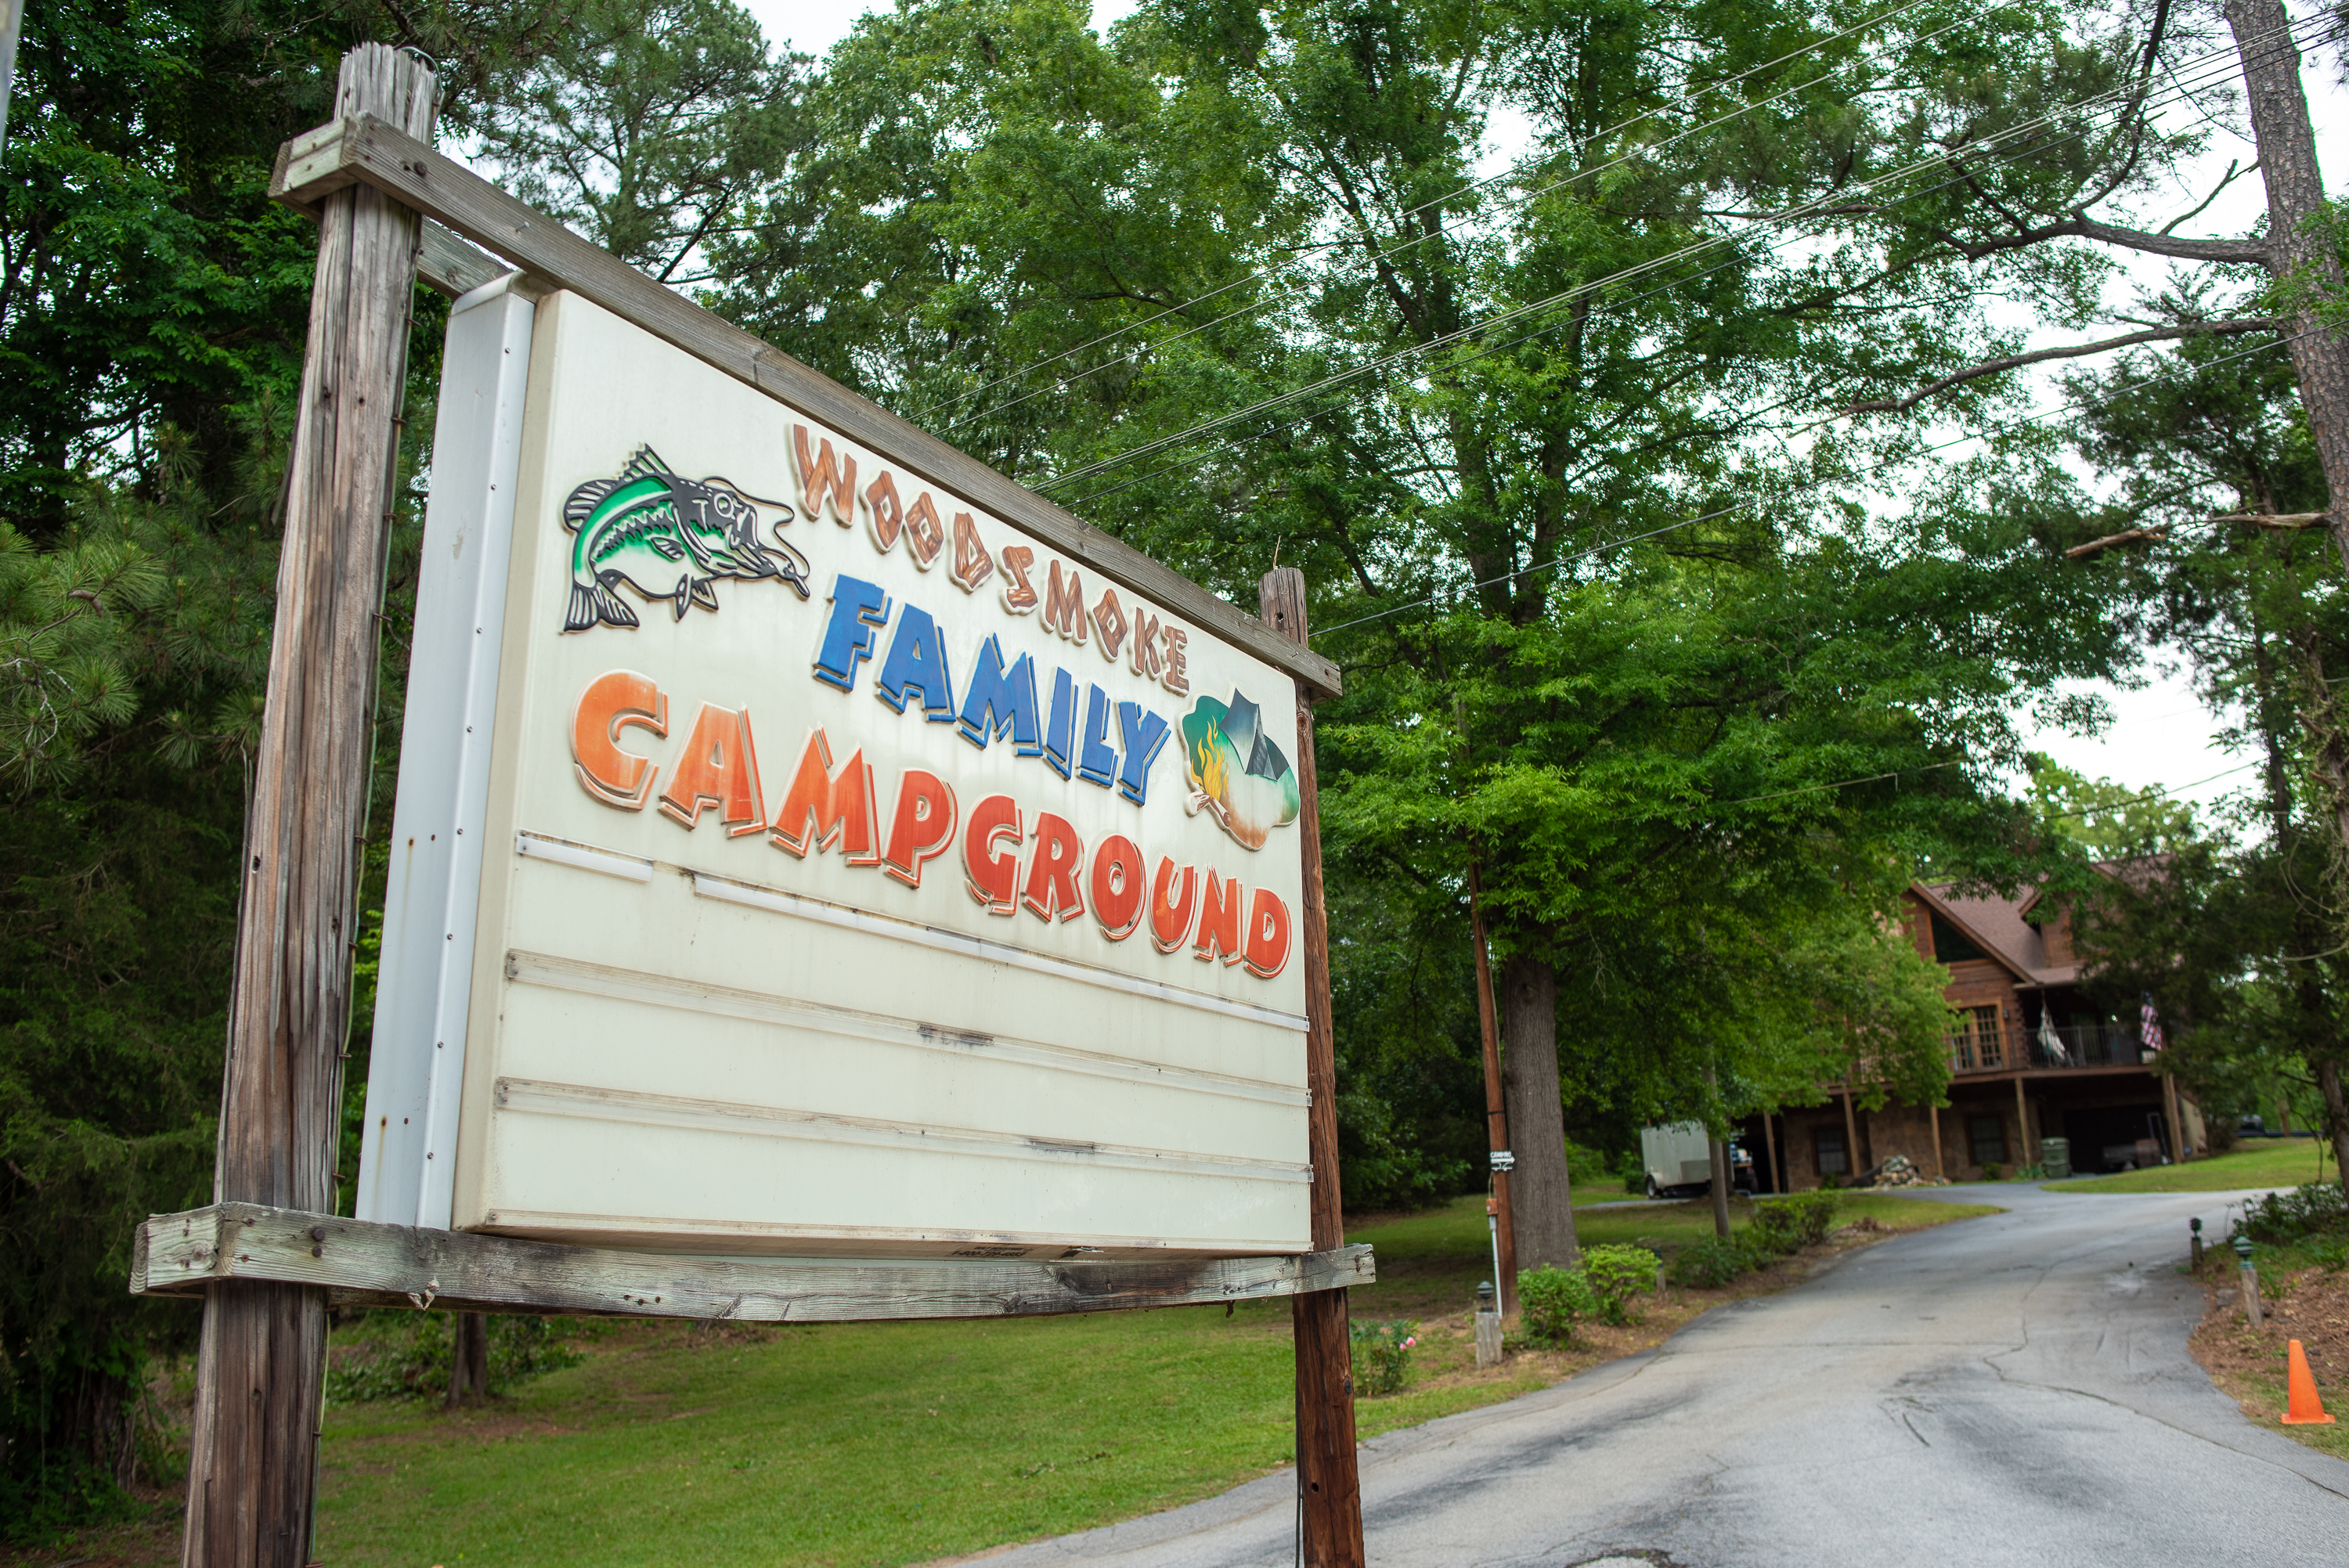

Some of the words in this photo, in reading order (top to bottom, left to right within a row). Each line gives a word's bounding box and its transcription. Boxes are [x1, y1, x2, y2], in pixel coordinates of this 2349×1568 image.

[792, 424, 1189, 694] WOODSMOKE
[812, 574, 1172, 806] FAMILY
[571, 669, 1293, 979] CAMPGROUND
